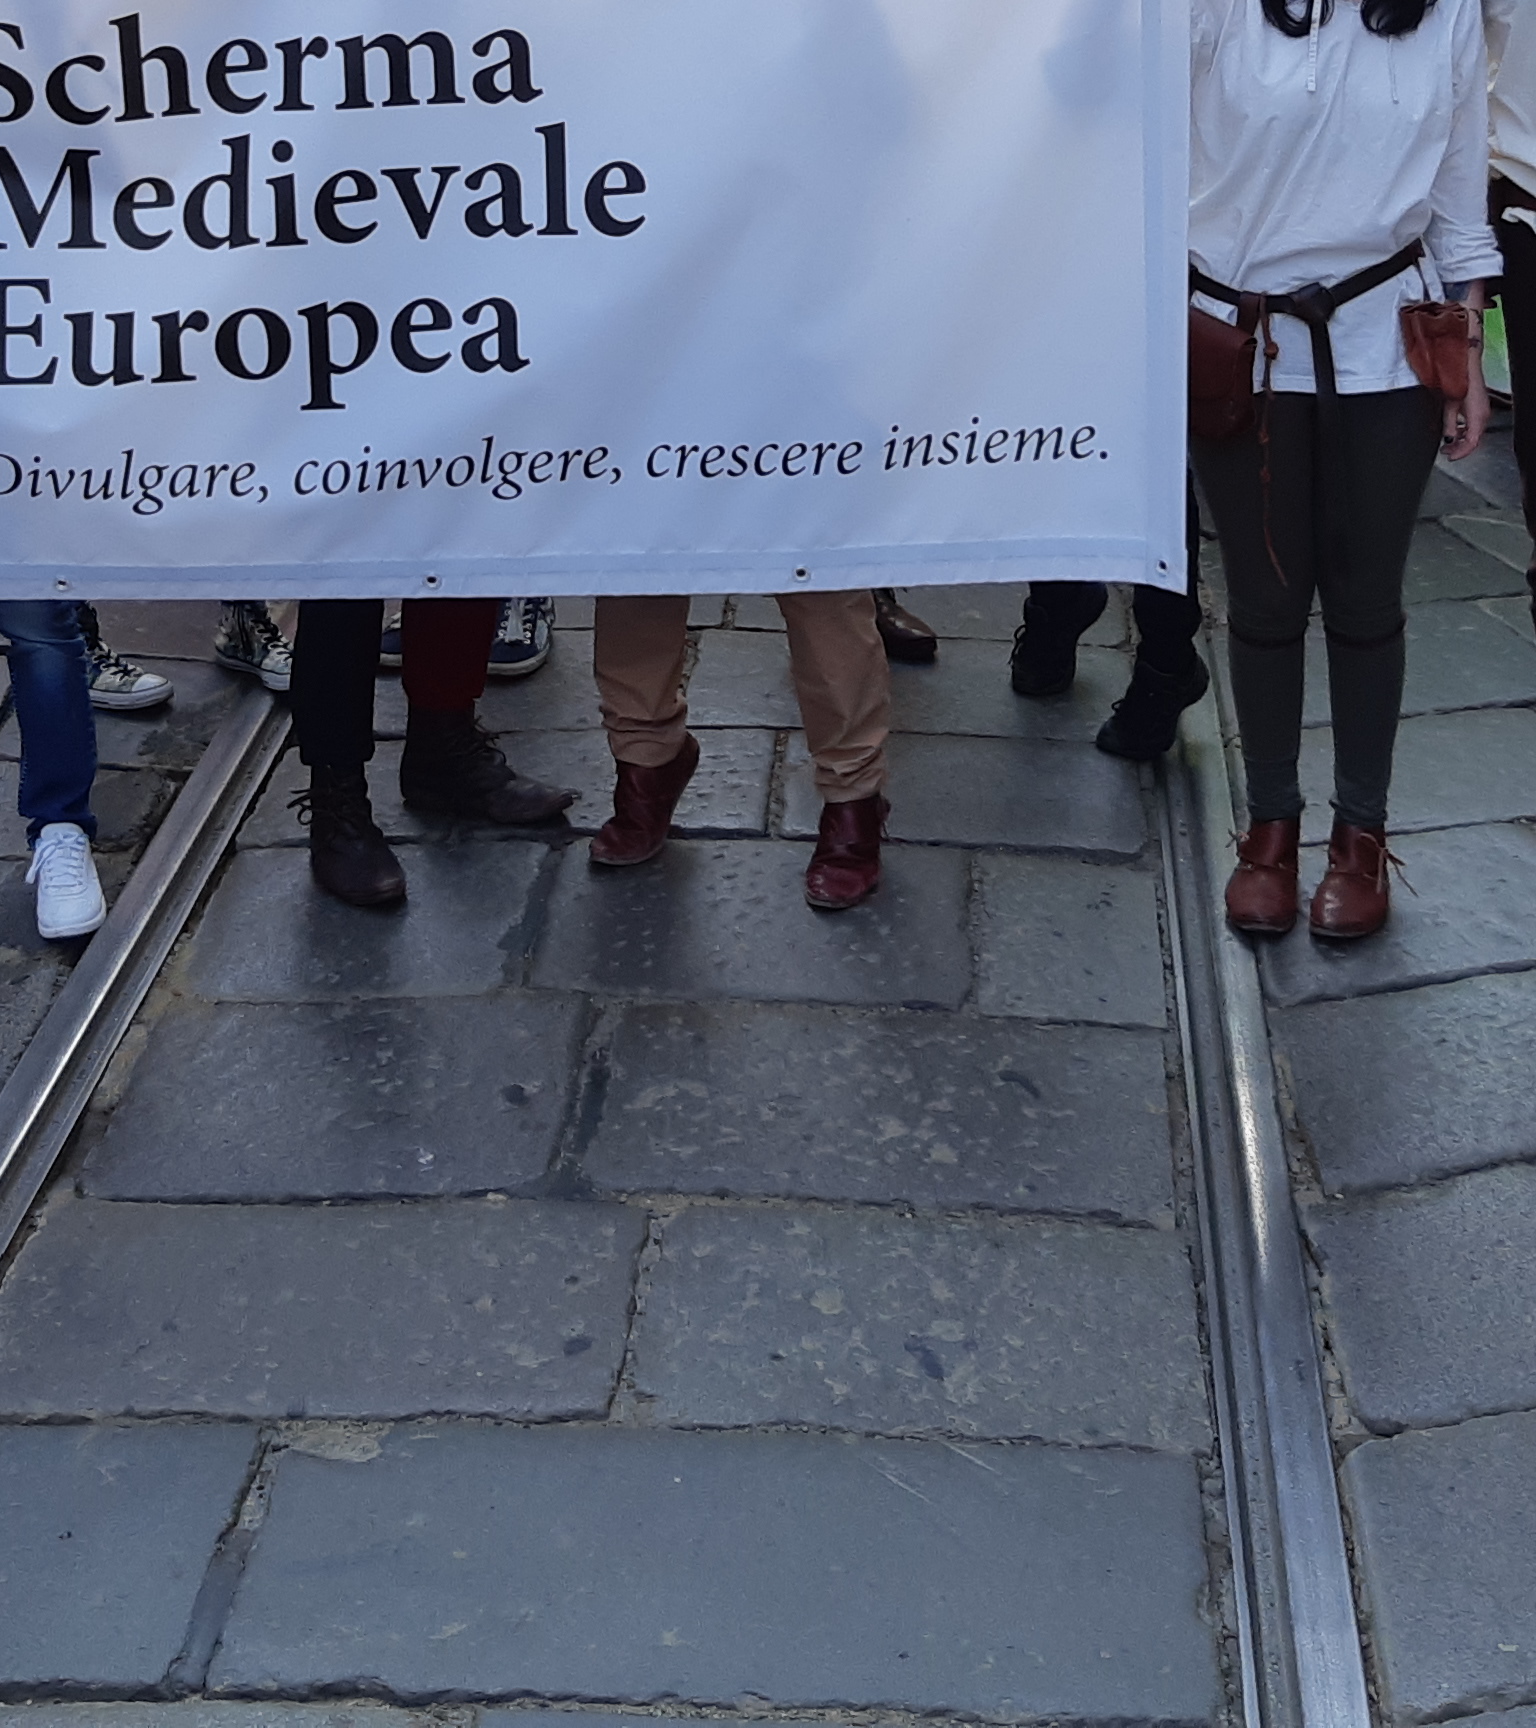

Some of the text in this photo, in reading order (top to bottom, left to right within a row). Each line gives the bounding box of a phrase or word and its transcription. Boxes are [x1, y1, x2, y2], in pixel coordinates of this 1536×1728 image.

[293, 437, 623, 514] coinvolgere,
[646, 441, 864, 480] crescere
[882, 416, 1110, 471] insieme.
